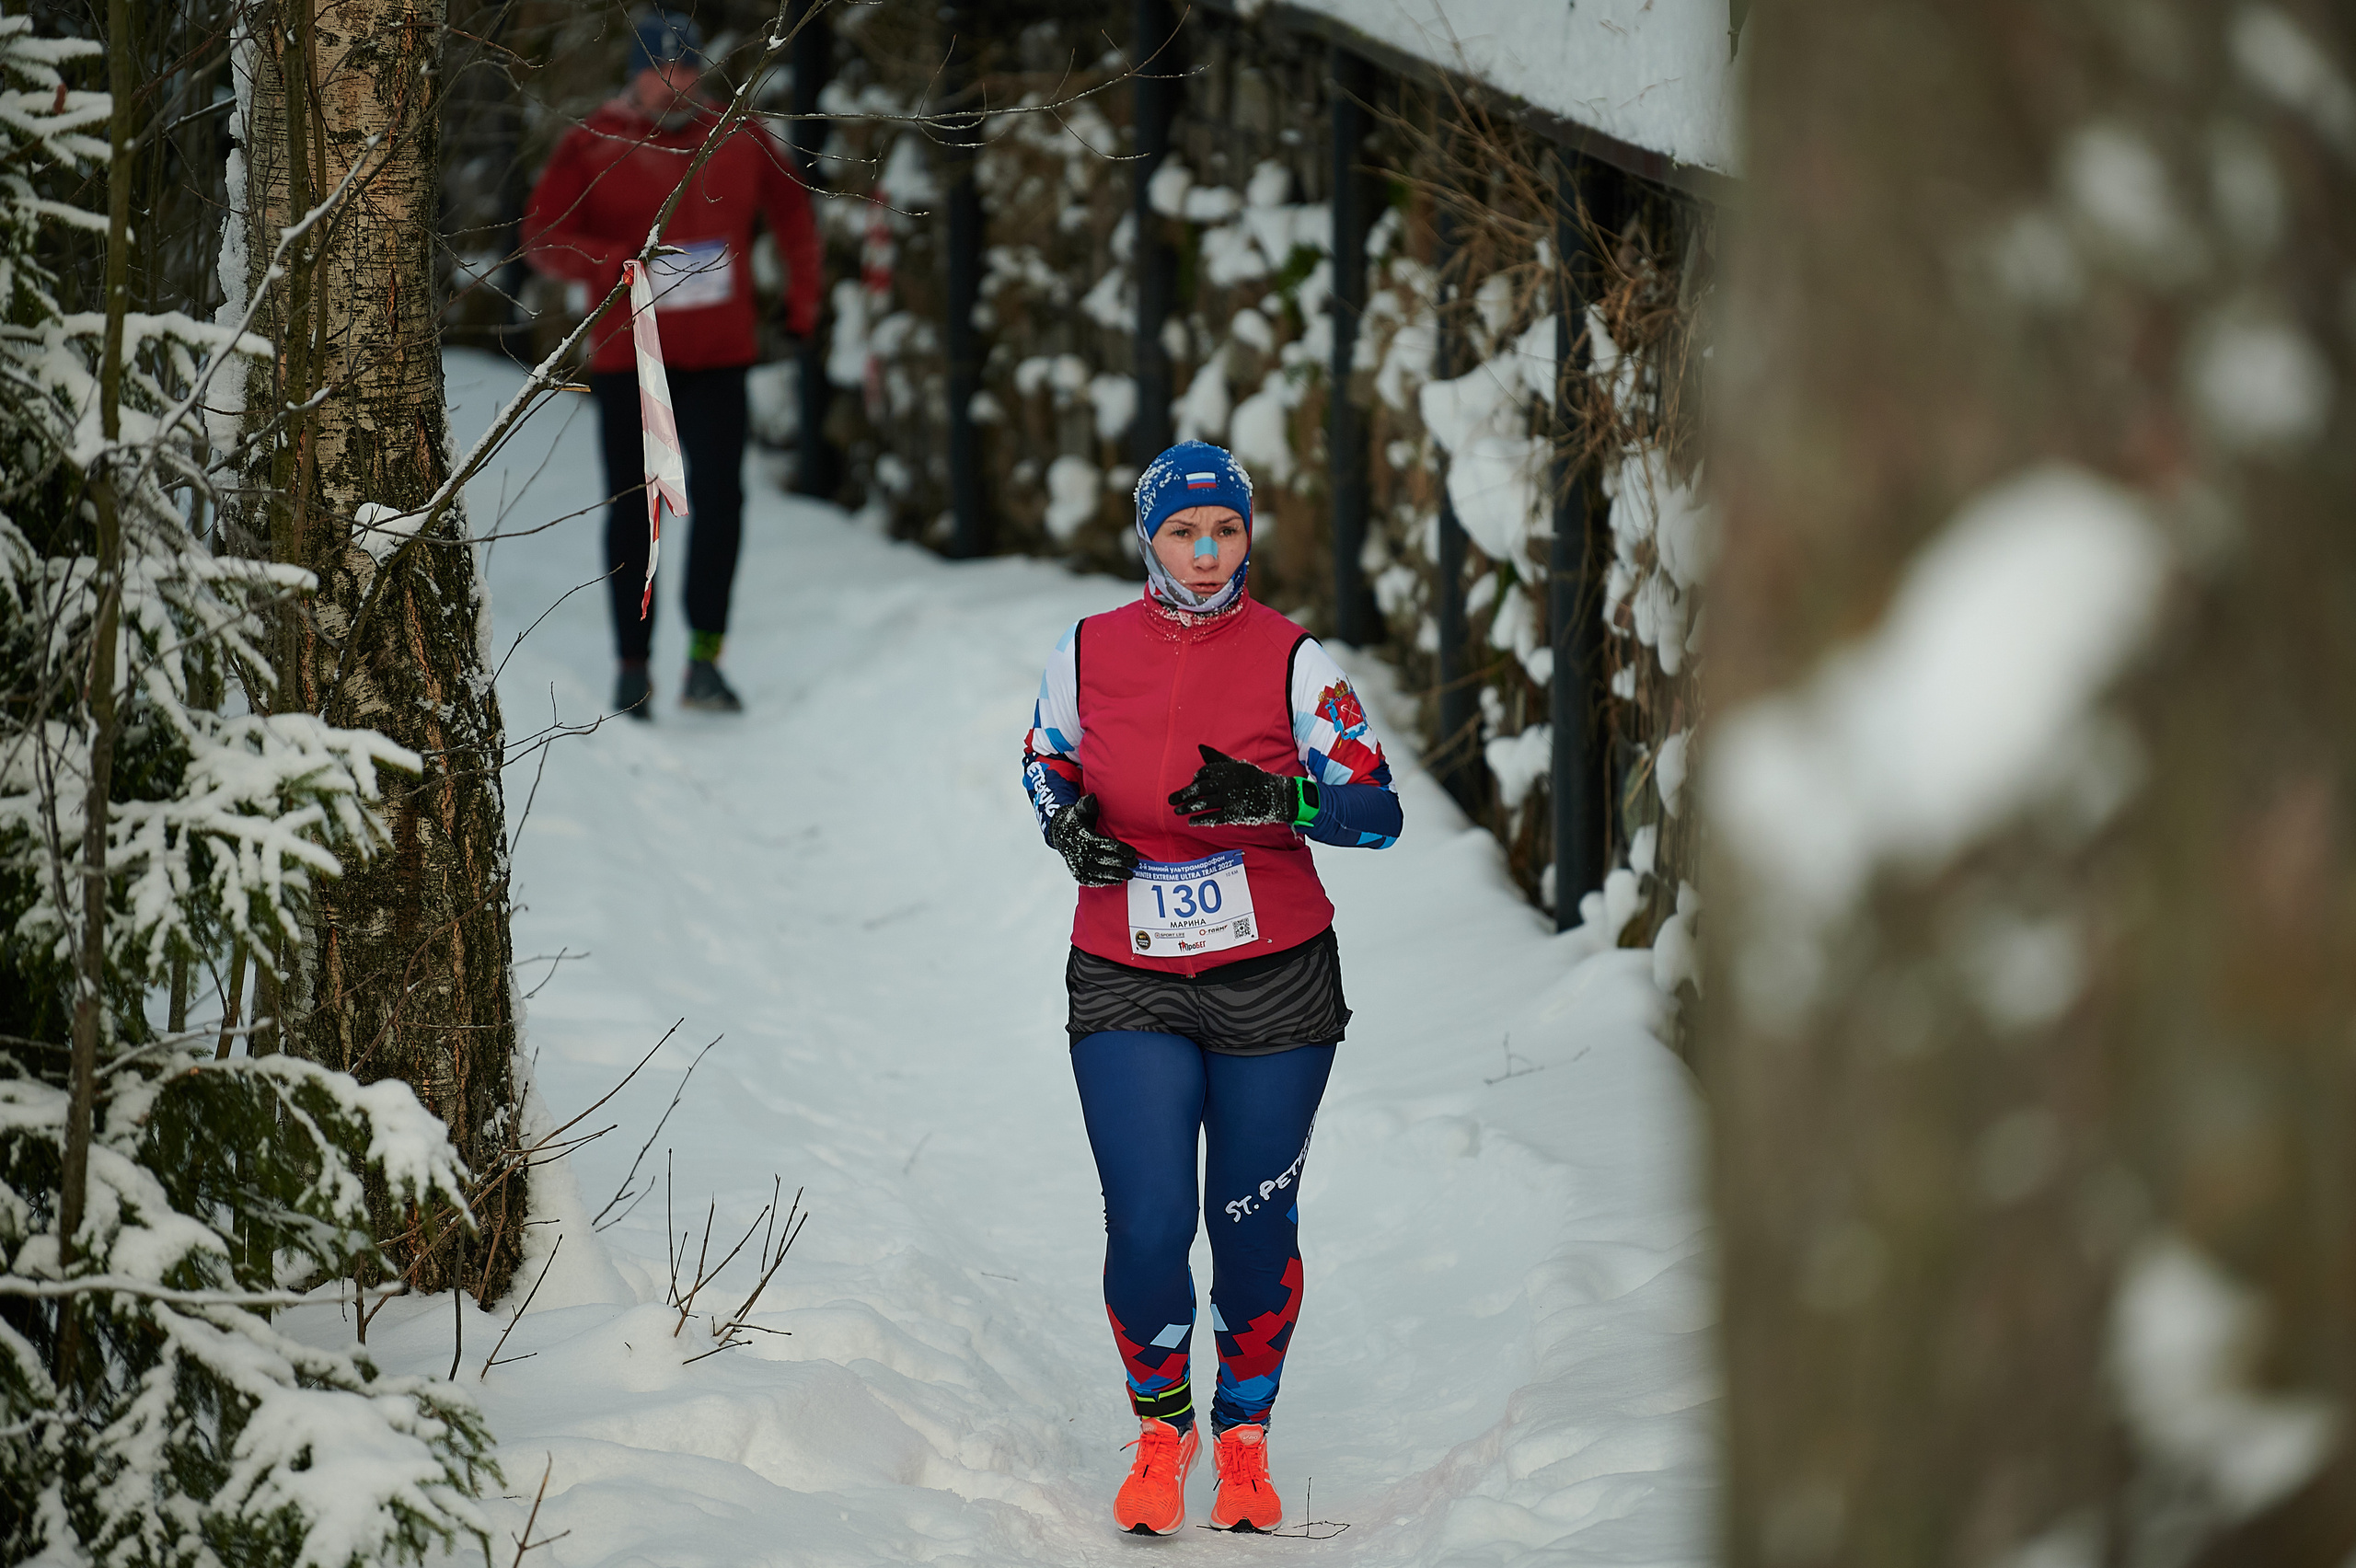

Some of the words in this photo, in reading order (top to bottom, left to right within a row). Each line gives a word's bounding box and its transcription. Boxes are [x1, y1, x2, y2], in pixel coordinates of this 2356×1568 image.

[1138, 862, 1148, 870] 2-й
[1169, 855, 1226, 874] ультрамарафон
[1180, 870, 1201, 881] ULTRA
[1201, 866, 1218, 877] TRAIL
[1150, 879, 1222, 918] 130
[1170, 918, 1207, 928] МАРИНА
[1225, 1194, 1260, 1223] ST.
